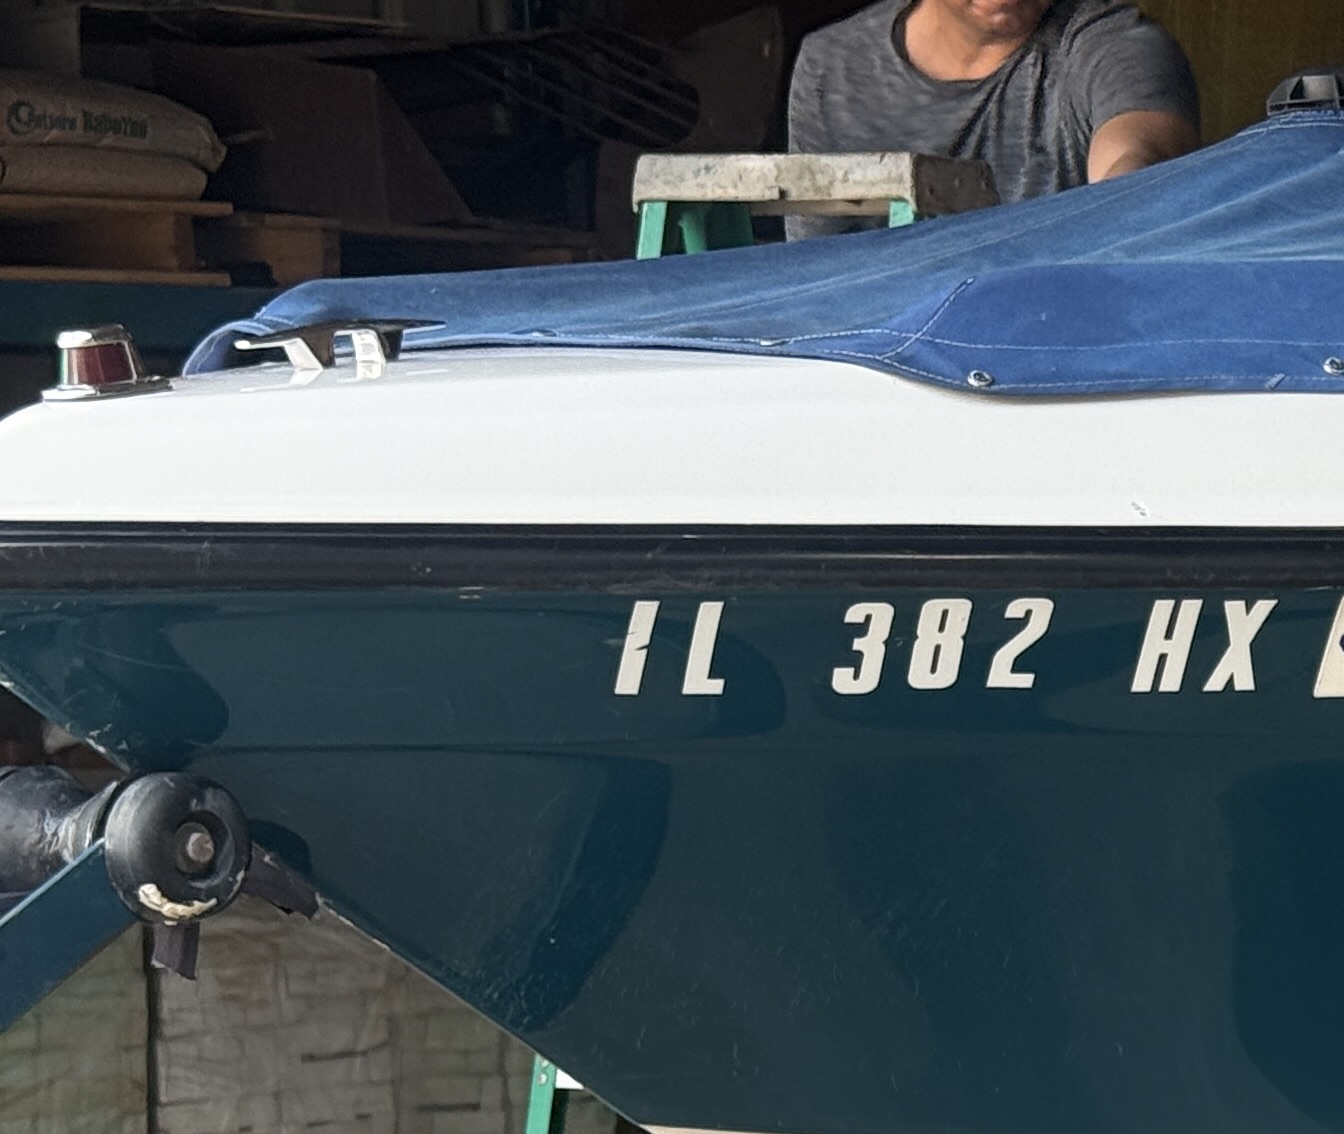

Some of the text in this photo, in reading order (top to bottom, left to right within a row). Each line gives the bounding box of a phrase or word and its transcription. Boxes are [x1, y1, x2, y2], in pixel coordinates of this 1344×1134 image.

[614, 597, 1278, 695] IL 382 HX
